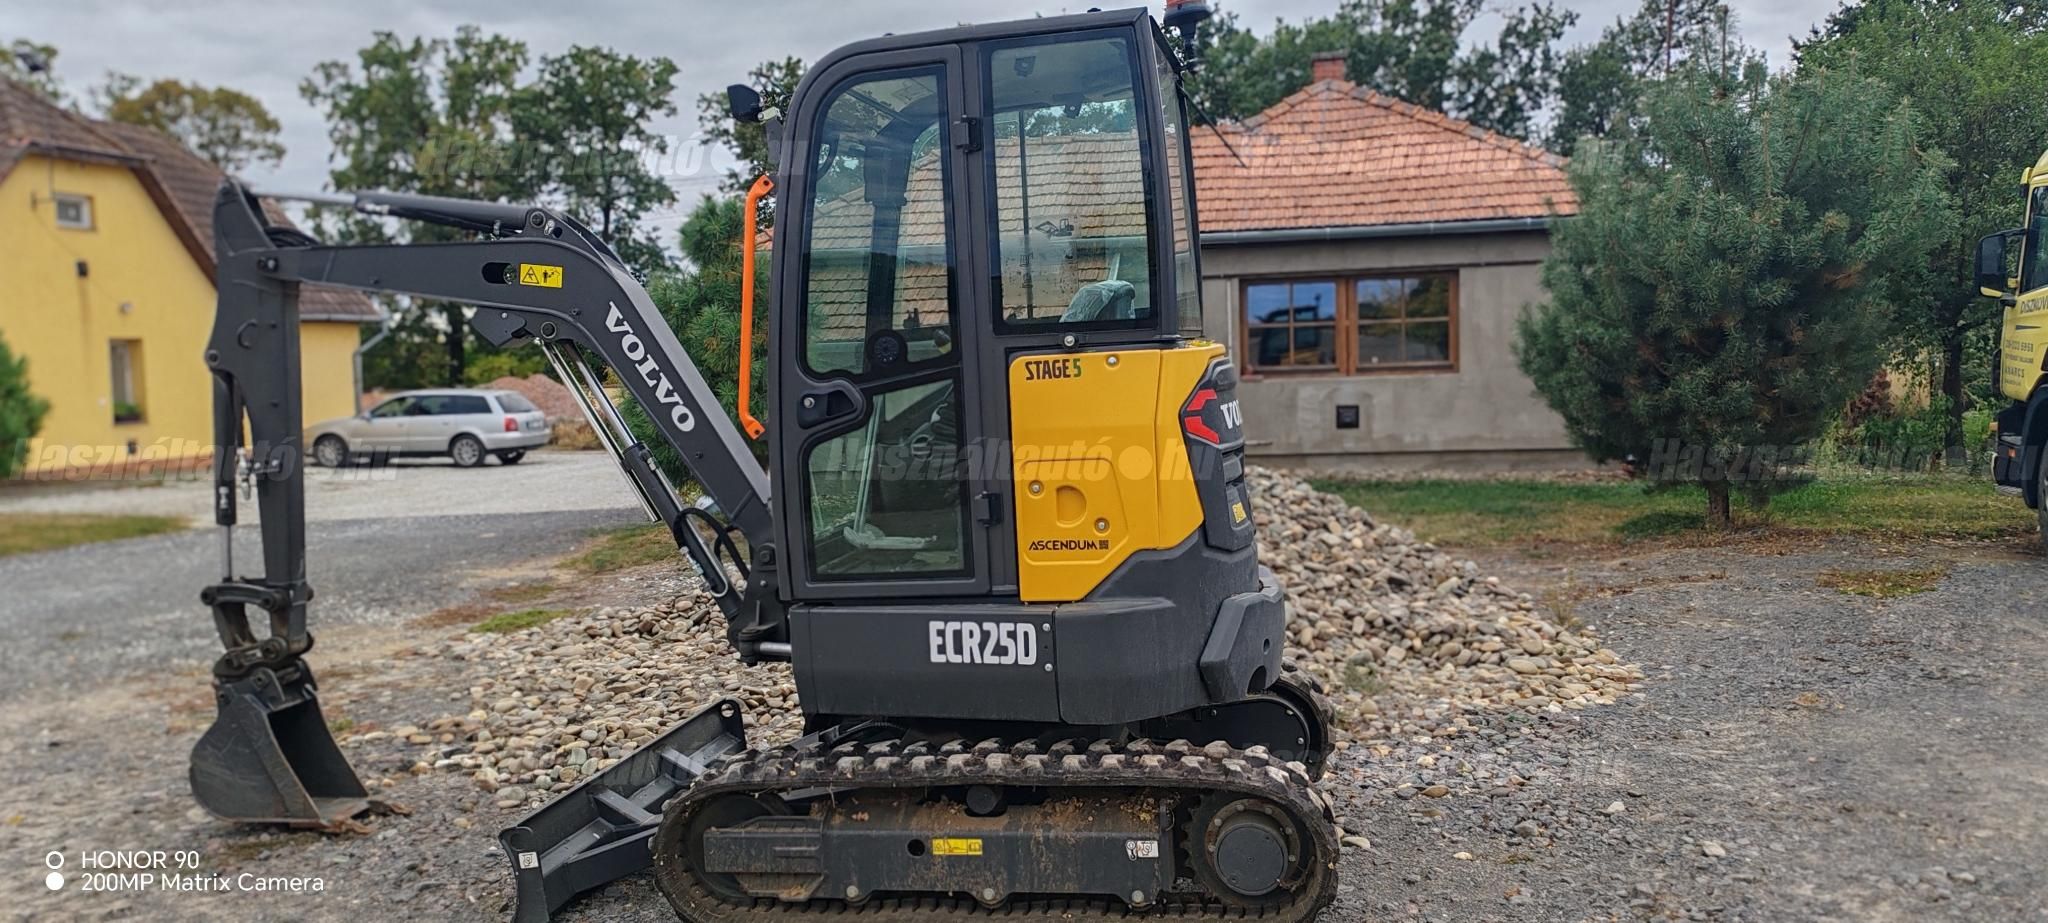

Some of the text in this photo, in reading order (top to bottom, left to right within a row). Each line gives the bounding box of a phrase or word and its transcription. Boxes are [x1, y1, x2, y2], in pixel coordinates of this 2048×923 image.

[605, 300, 695, 432] VOLVO
[1025, 358, 1082, 381] STAGE 5
[1028, 540, 1098, 551] ASCENDUM
[929, 620, 1037, 665] ECR25D
